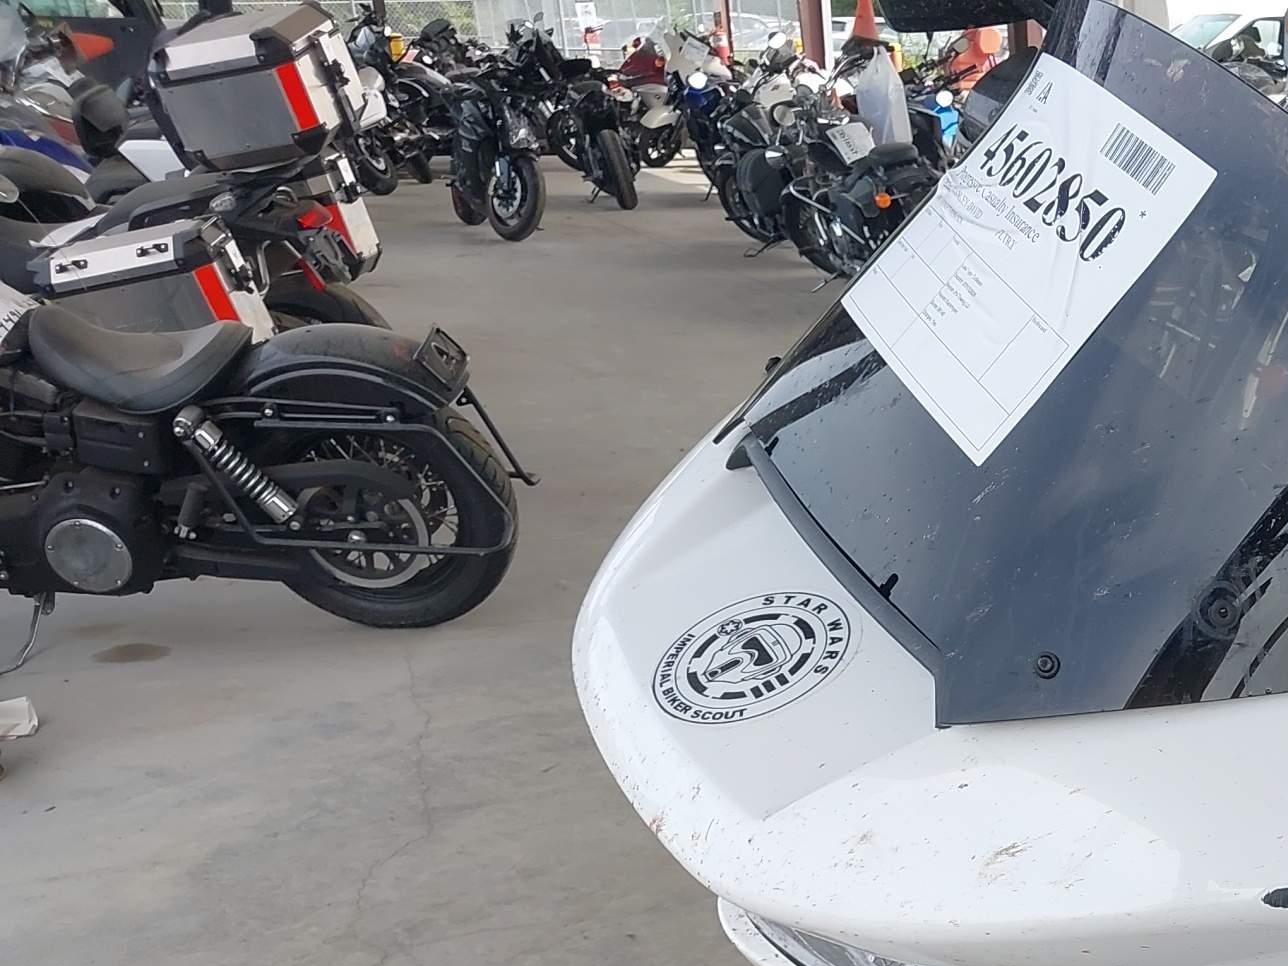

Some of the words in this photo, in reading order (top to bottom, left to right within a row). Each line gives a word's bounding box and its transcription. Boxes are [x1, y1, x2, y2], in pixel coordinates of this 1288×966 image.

[979, 122, 1126, 263] 45602850
[981, 187, 1010, 218] Casualty
[1004, 204, 1041, 244] Insurance
[659, 632, 696, 688] IMPERIAL
[761, 595, 829, 615] STAR
[813, 617, 845, 675] WARS
[662, 687, 692, 715] BIKER
[690, 707, 748, 722] SCOUT
